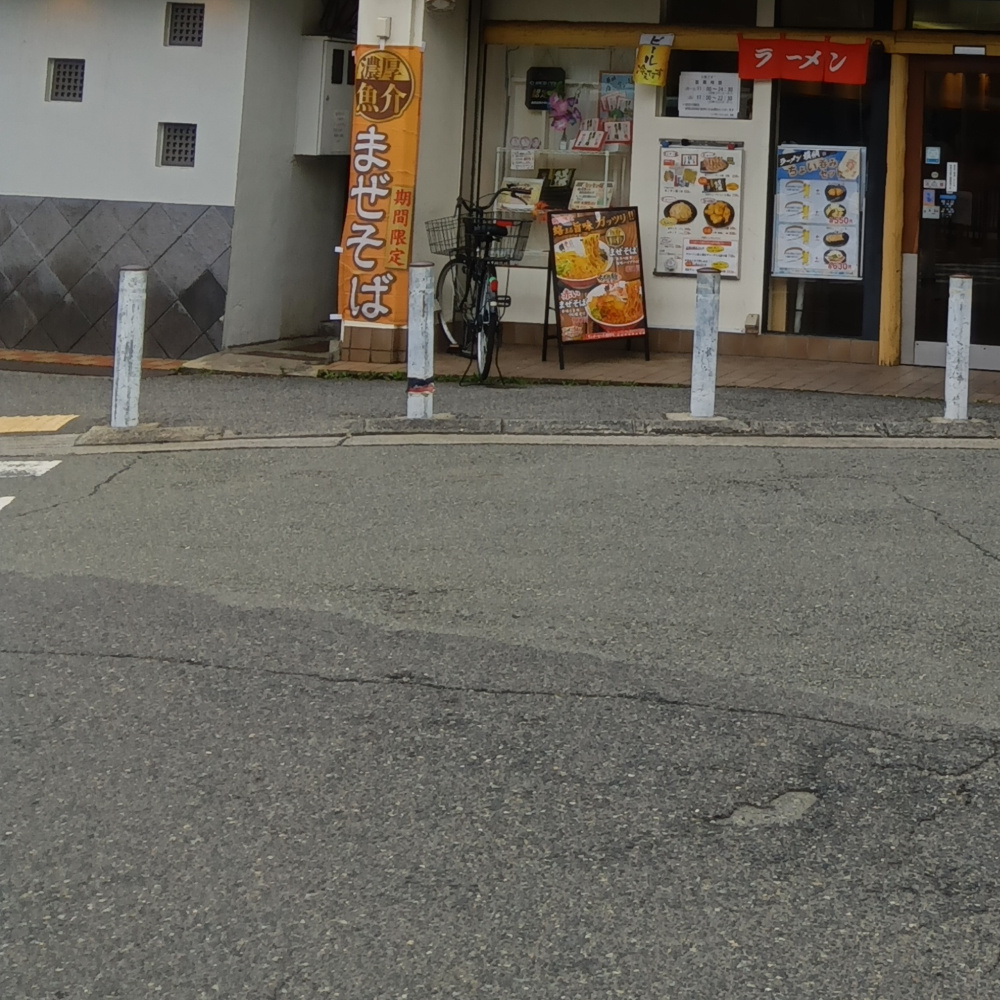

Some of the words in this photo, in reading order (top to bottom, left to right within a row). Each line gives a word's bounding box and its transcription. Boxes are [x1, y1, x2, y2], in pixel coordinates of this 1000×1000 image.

[644, 35, 665, 66] ビール
[753, 47, 848, 73] ラーメン
[360, 54, 403, 80] 濃厚
[356, 81, 408, 114] 魚介
[346, 125, 396, 319] まぜそば
[389, 189, 412, 267] 期間限定
